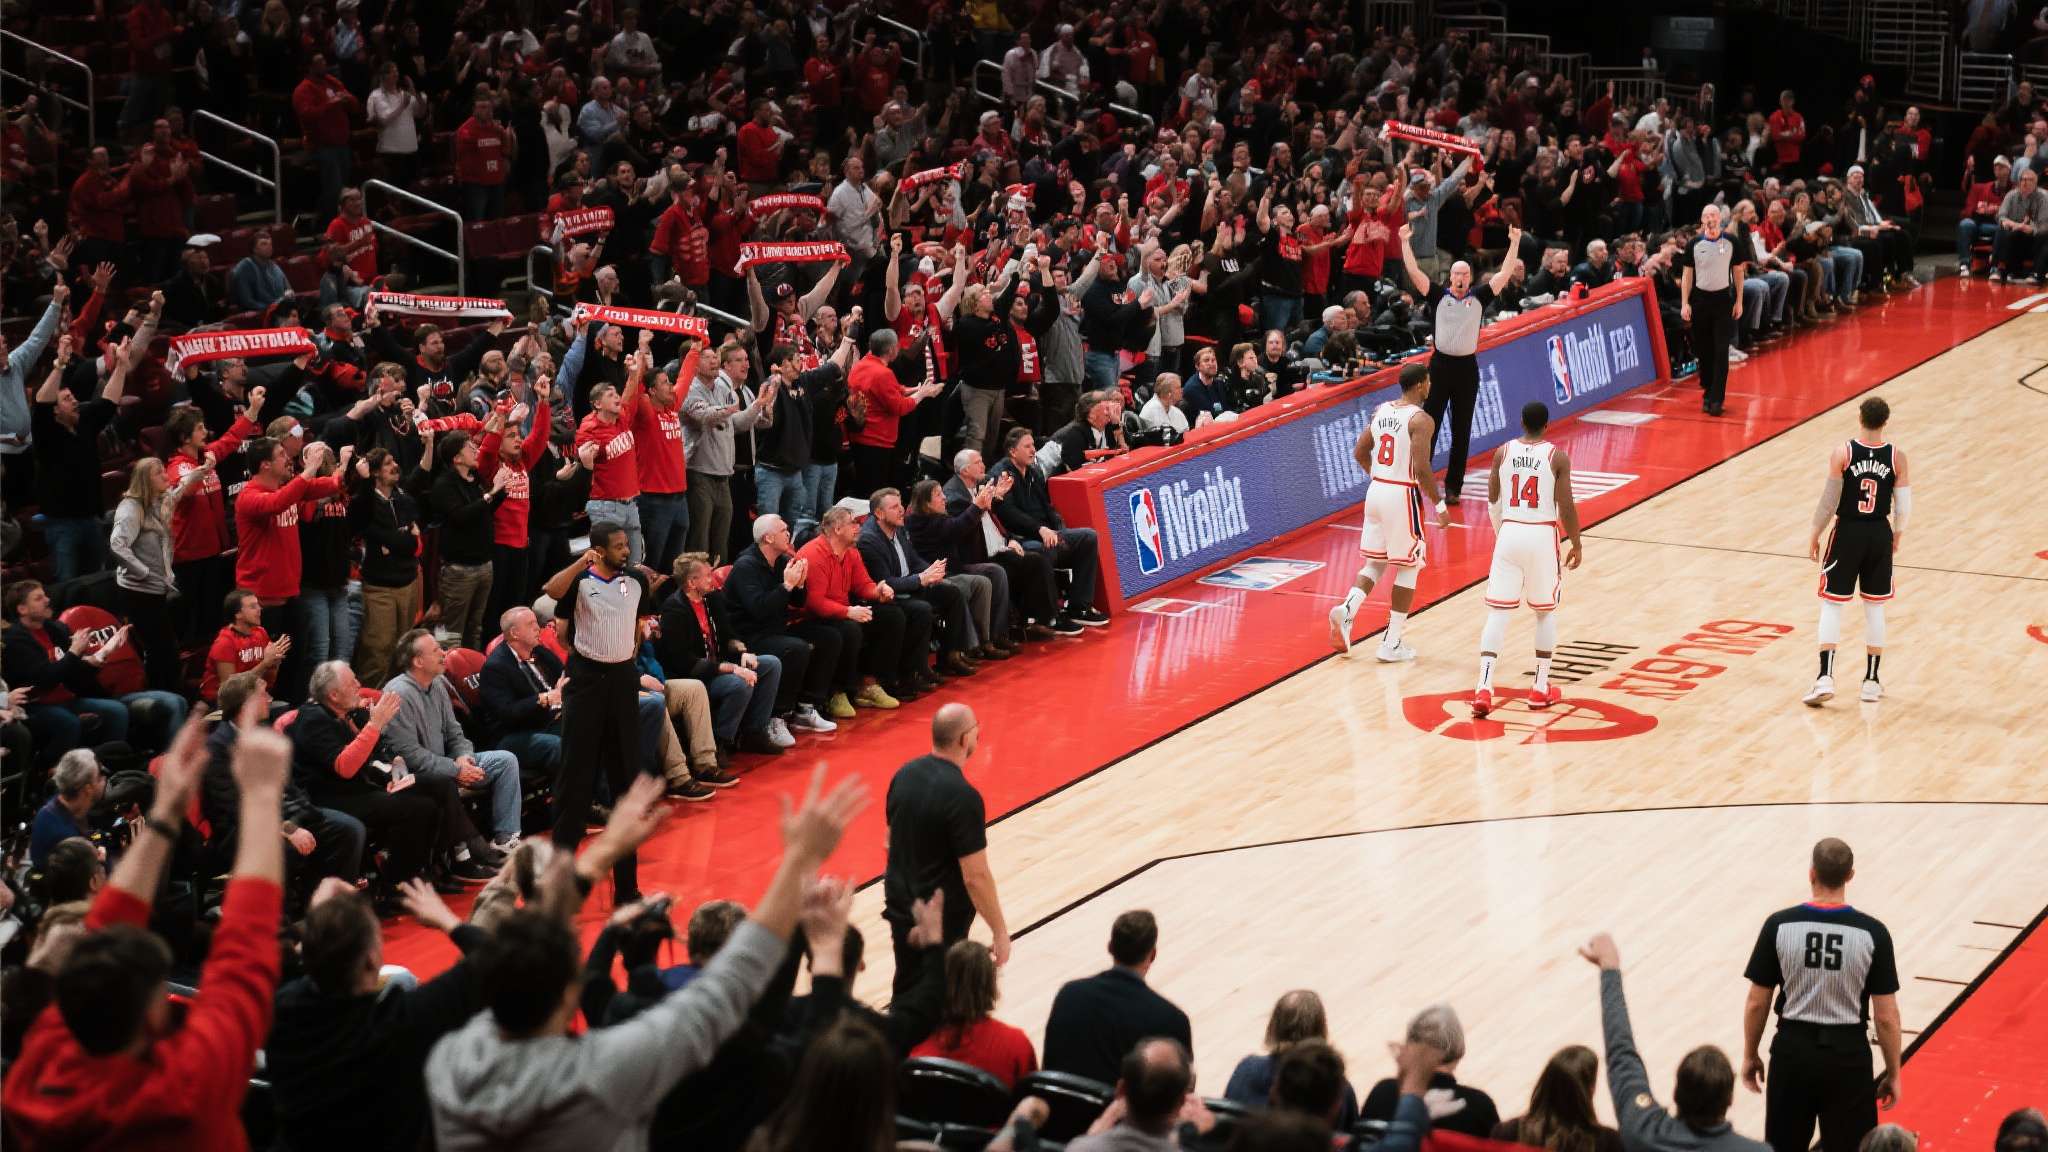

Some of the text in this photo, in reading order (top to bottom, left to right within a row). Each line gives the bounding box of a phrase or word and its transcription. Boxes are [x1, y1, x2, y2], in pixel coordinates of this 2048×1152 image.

[1378, 433, 1394, 466] 8
[1510, 474, 1539, 508] 14
[1858, 479, 1877, 513] 3
[1805, 931, 1843, 970] 85
